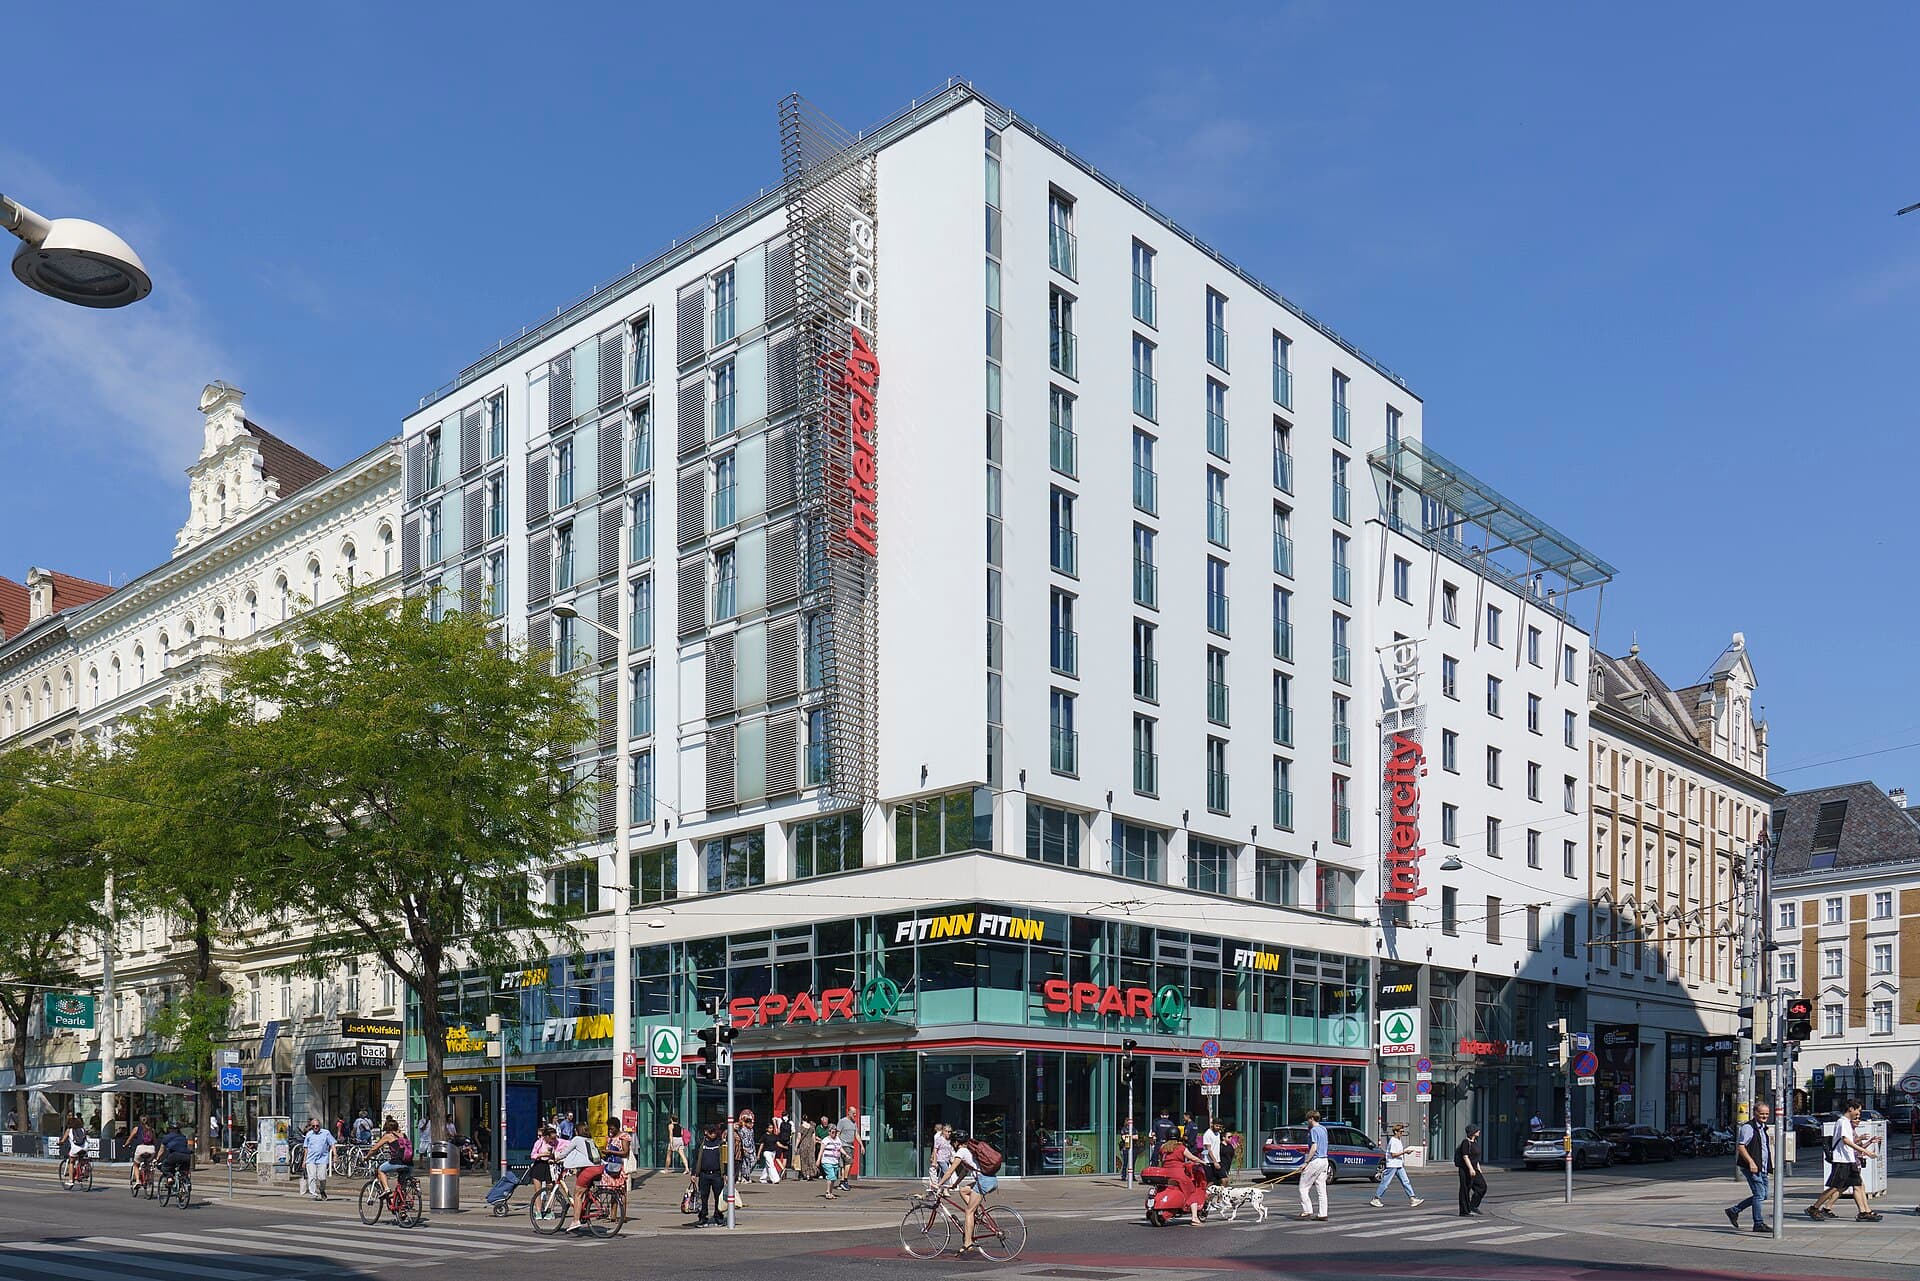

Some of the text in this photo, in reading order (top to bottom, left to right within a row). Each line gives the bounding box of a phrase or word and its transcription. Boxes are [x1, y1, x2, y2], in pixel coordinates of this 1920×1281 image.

[1043, 979, 1154, 1019] SPAR
[729, 987, 855, 1028] SPAR
[55, 1015, 86, 1026] Pearle
[347, 1023, 401, 1036] Jack Wolfskin
[446, 1025, 469, 1040] Jack
[363, 1045, 385, 1057] back
[1382, 1045, 1415, 1054] SPAR
[361, 1058, 387, 1067] WERK
[652, 1066, 680, 1075] SPAR
